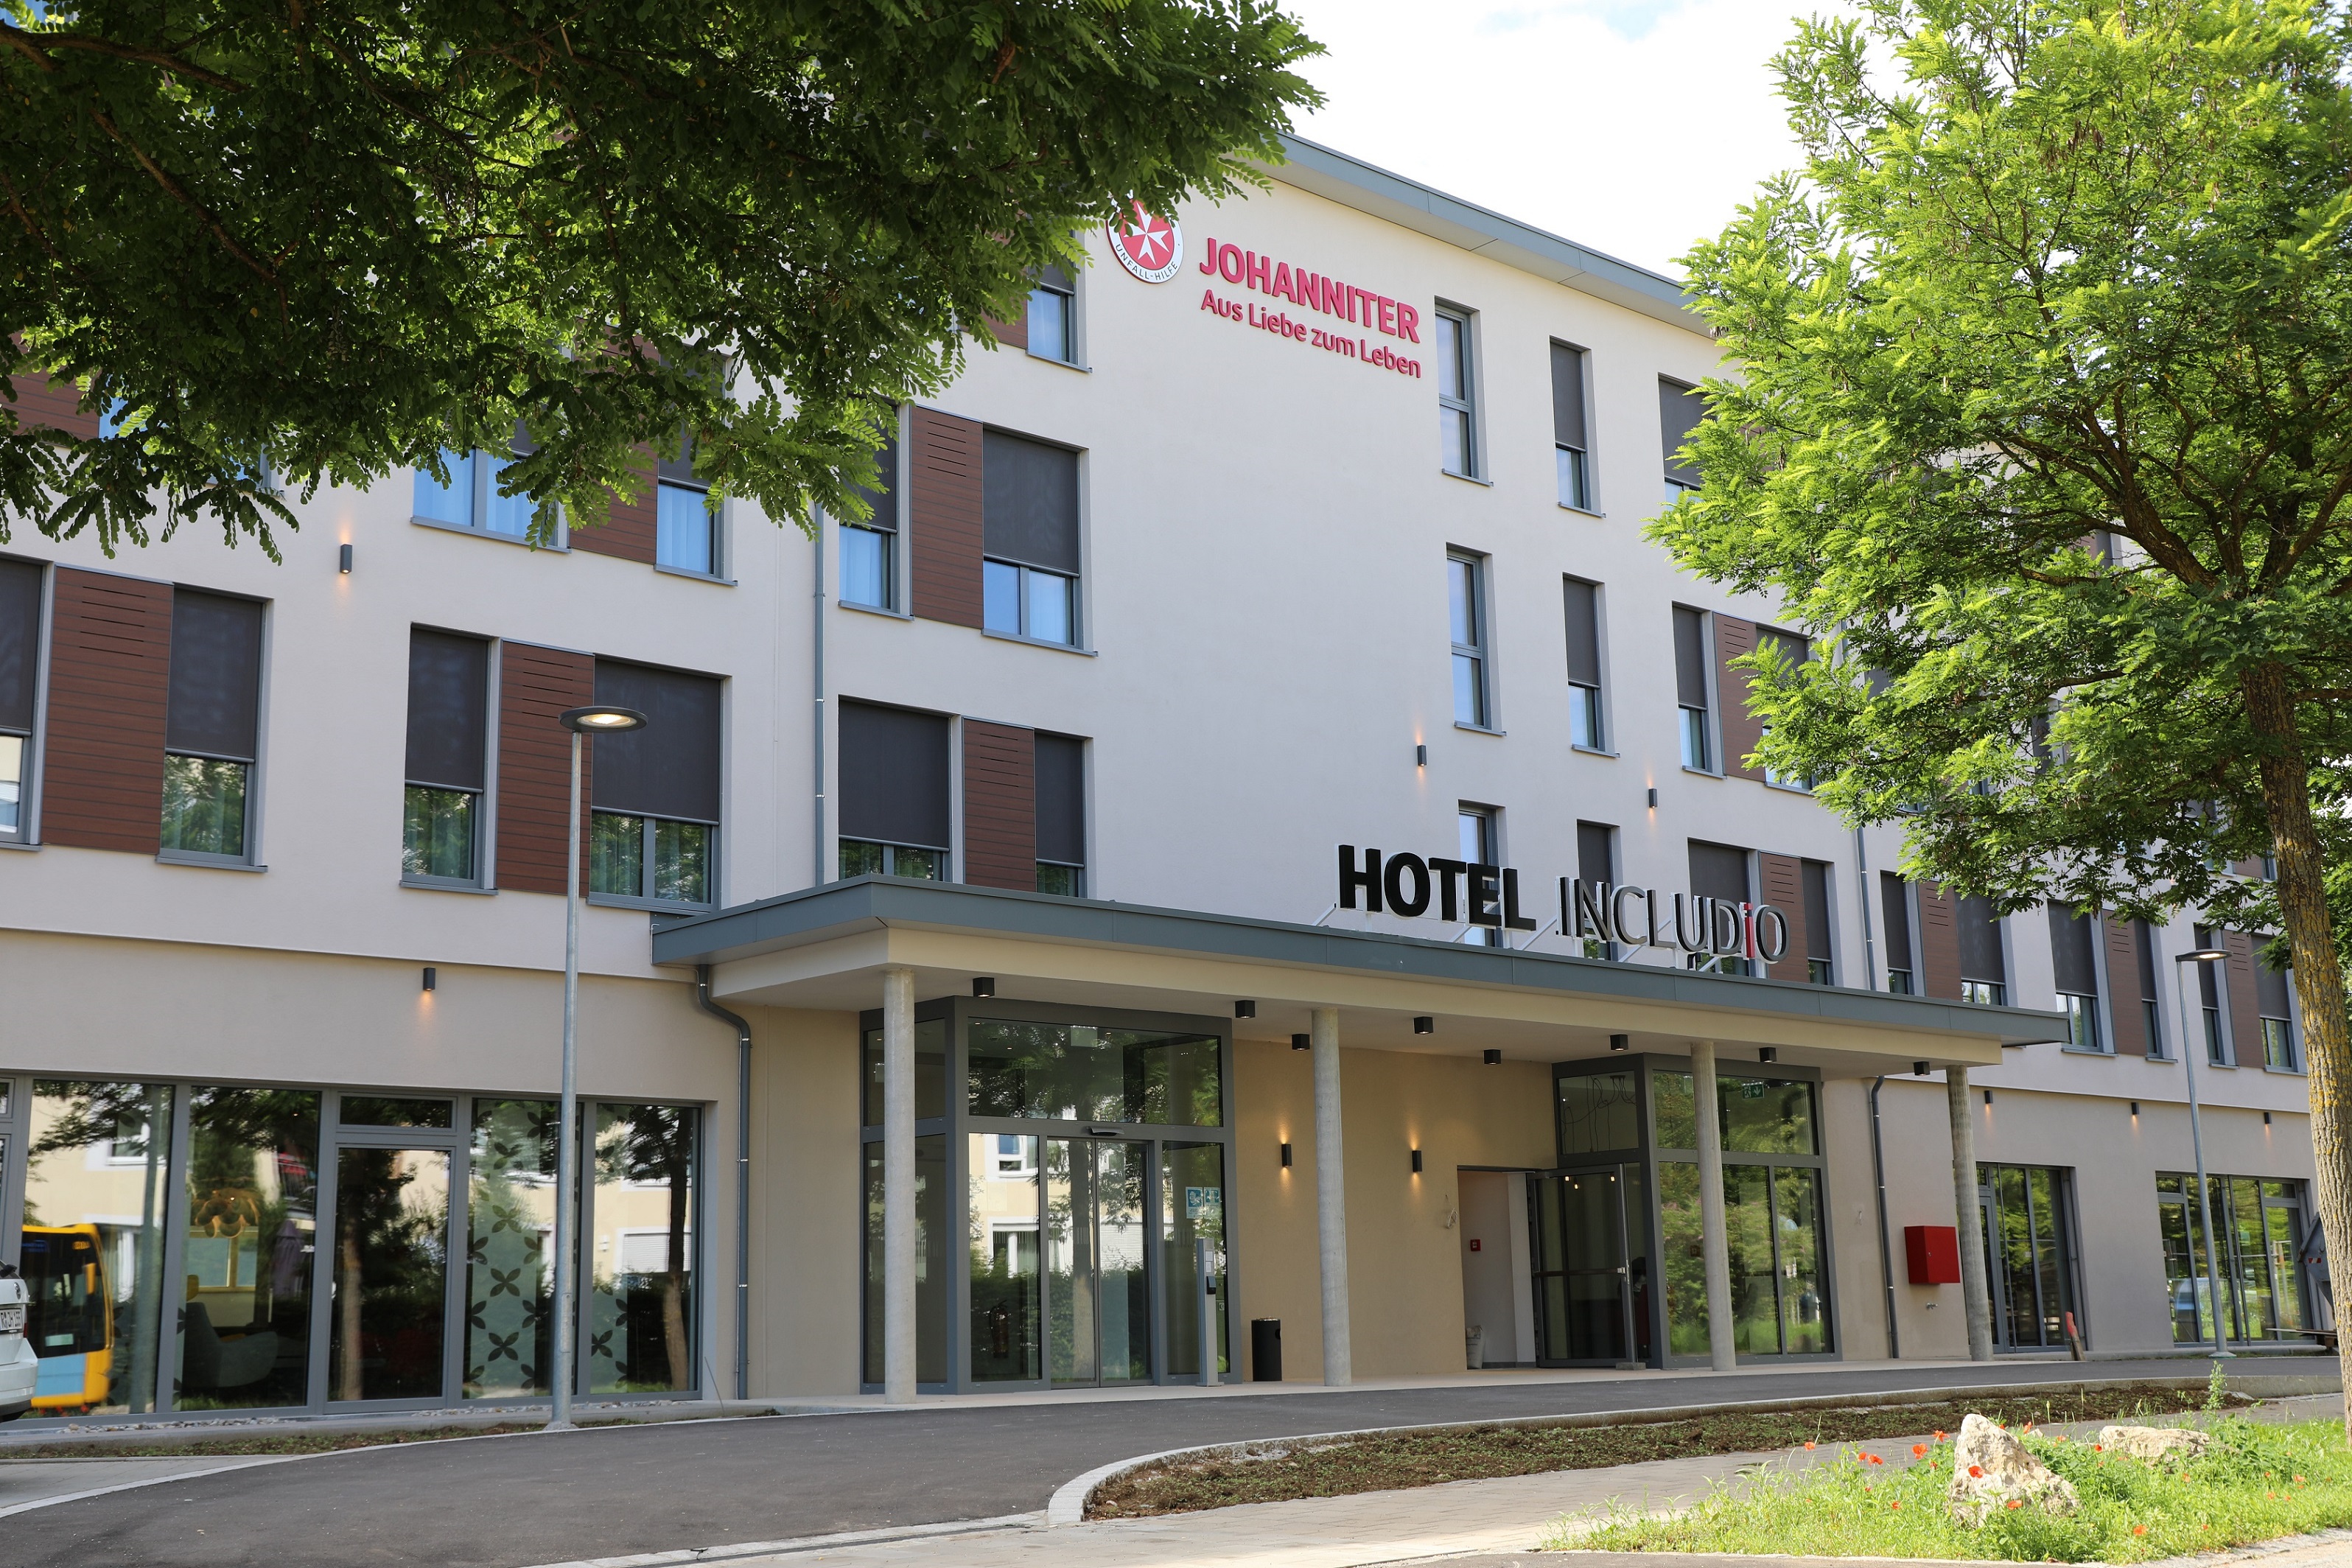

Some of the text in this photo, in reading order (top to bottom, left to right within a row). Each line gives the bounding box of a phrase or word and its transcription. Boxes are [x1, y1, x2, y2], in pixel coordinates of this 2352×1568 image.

[1115, 243, 1178, 281] UNFALL-HILFE
[1200, 237, 1421, 343] JOHANNITER
[1201, 289, 1421, 379] Aus Liebe zum Leben
[1337, 844, 1537, 932] HOTEL
